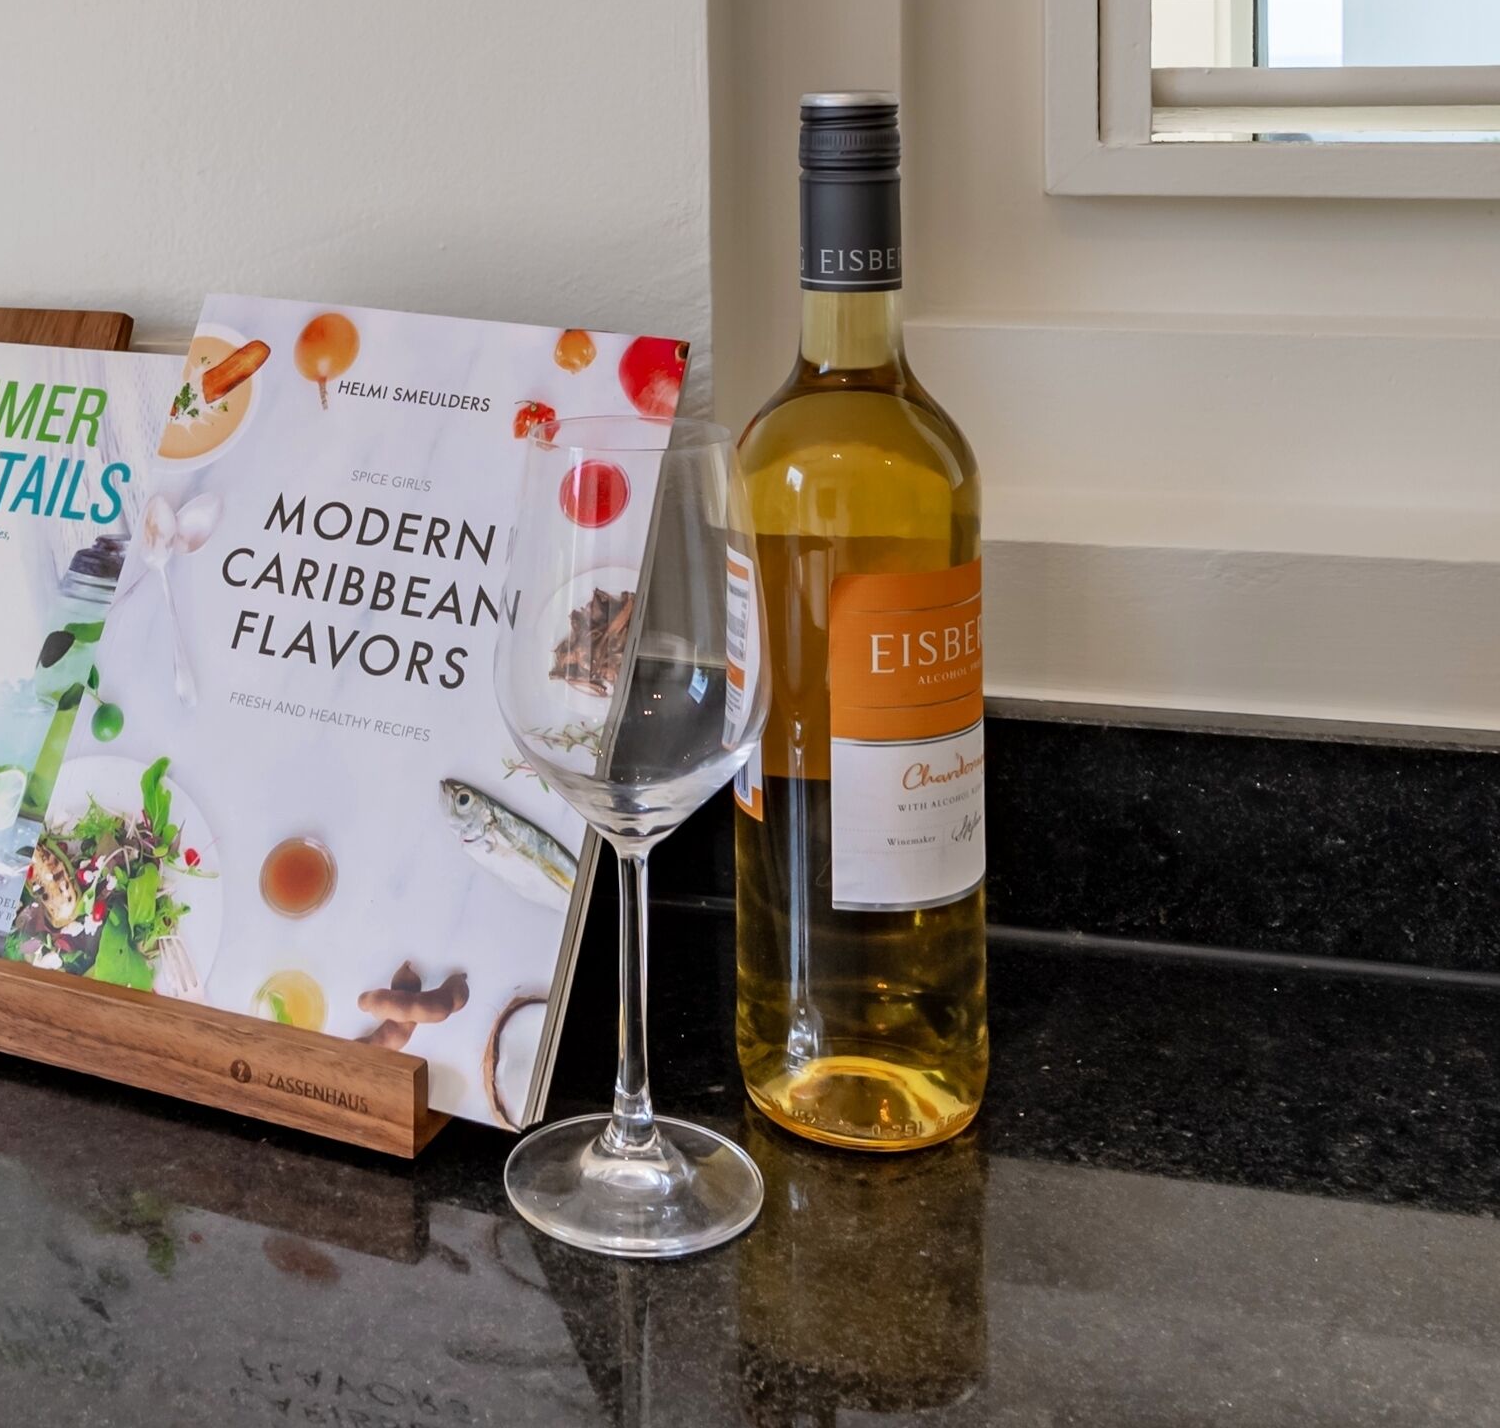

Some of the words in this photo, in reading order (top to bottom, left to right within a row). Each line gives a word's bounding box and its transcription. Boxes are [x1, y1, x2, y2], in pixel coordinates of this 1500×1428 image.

[338, 380, 388, 400] HELMI
[392, 387, 491, 412] SMEULDERS
[351, 470, 389, 486] SPICE
[392, 475, 432, 492] GIRL'S
[264, 492, 496, 566] MODERN
[222, 548, 522, 630] CARIBBEAN
[231, 610, 469, 689] FLAVORS
[918, 667, 967, 684] ALCOHOL
[229, 691, 272, 710] FRESH
[274, 701, 306, 717] AND
[310, 708, 371, 730] HEALTHY
[373, 720, 431, 742] RECIPES
[897, 802, 927, 812] WITH
[887, 835, 936, 846] Winemaker
[266, 1073, 369, 1114] ZASSENHAUS
